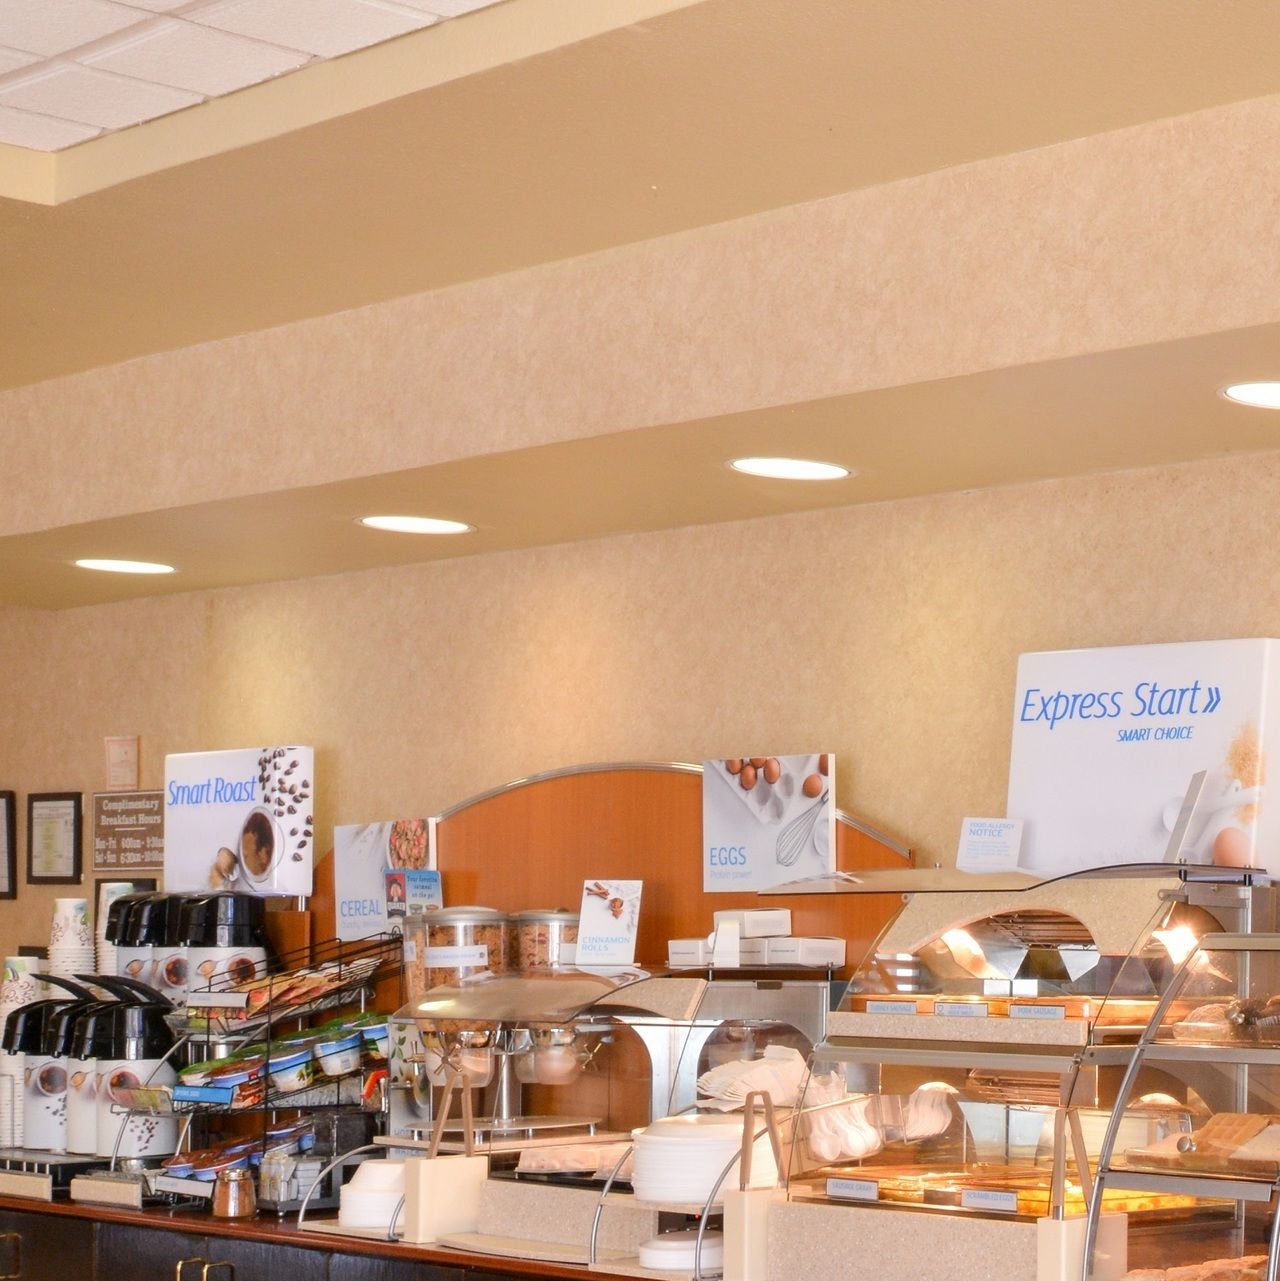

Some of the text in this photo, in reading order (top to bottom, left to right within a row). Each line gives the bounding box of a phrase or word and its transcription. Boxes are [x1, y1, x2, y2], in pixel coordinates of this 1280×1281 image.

[1020, 680, 1202, 730] Express Start
[1116, 726, 1195, 743] SMART CHOICE
[168, 776, 258, 806] Smart Roast
[102, 799, 160, 812] Complimentary
[100, 813, 161, 826] Breakfast Hours
[968, 829, 1003, 837] NOTICE
[710, 846, 747, 866] EGGS
[340, 899, 383, 917] CEREAL
[582, 936, 631, 944] CINNAMON
